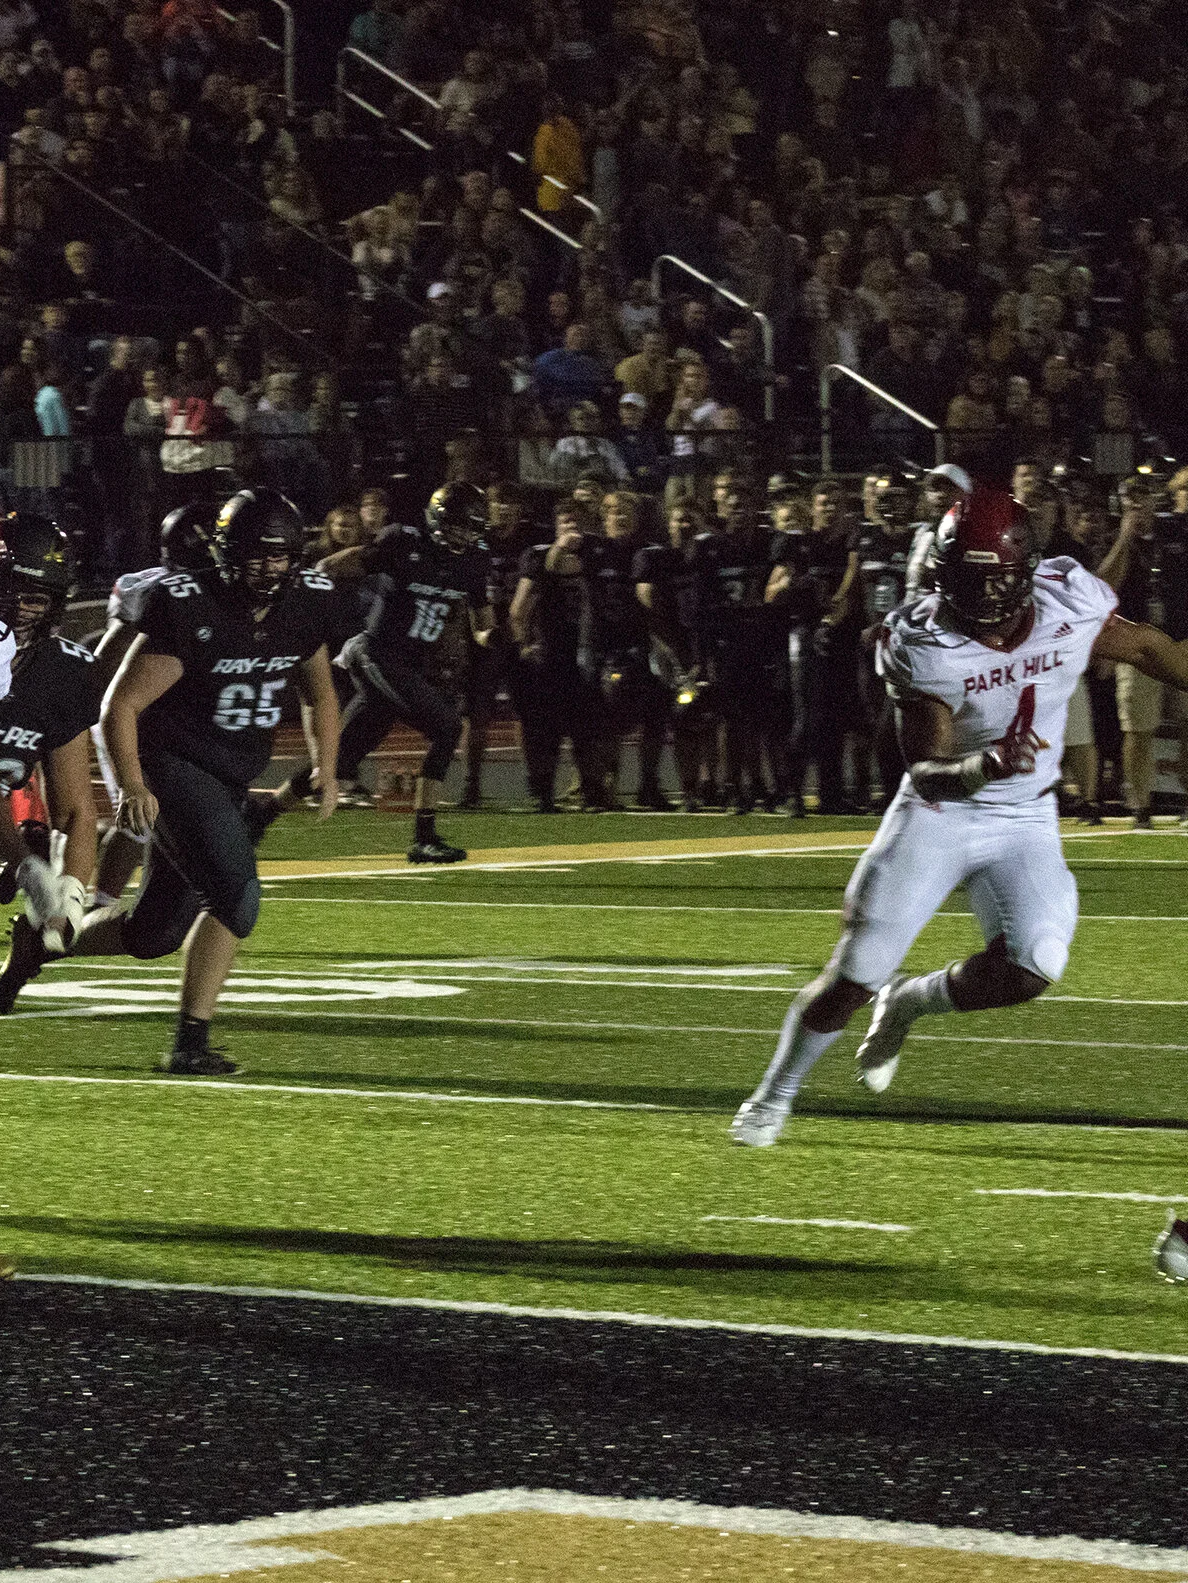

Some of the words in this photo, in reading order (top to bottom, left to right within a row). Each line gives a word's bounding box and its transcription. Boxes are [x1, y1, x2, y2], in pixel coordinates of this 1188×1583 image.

[963, 663, 1016, 697] PARK
[1023, 650, 1064, 679] HILL
[212, 677, 289, 731] 65
